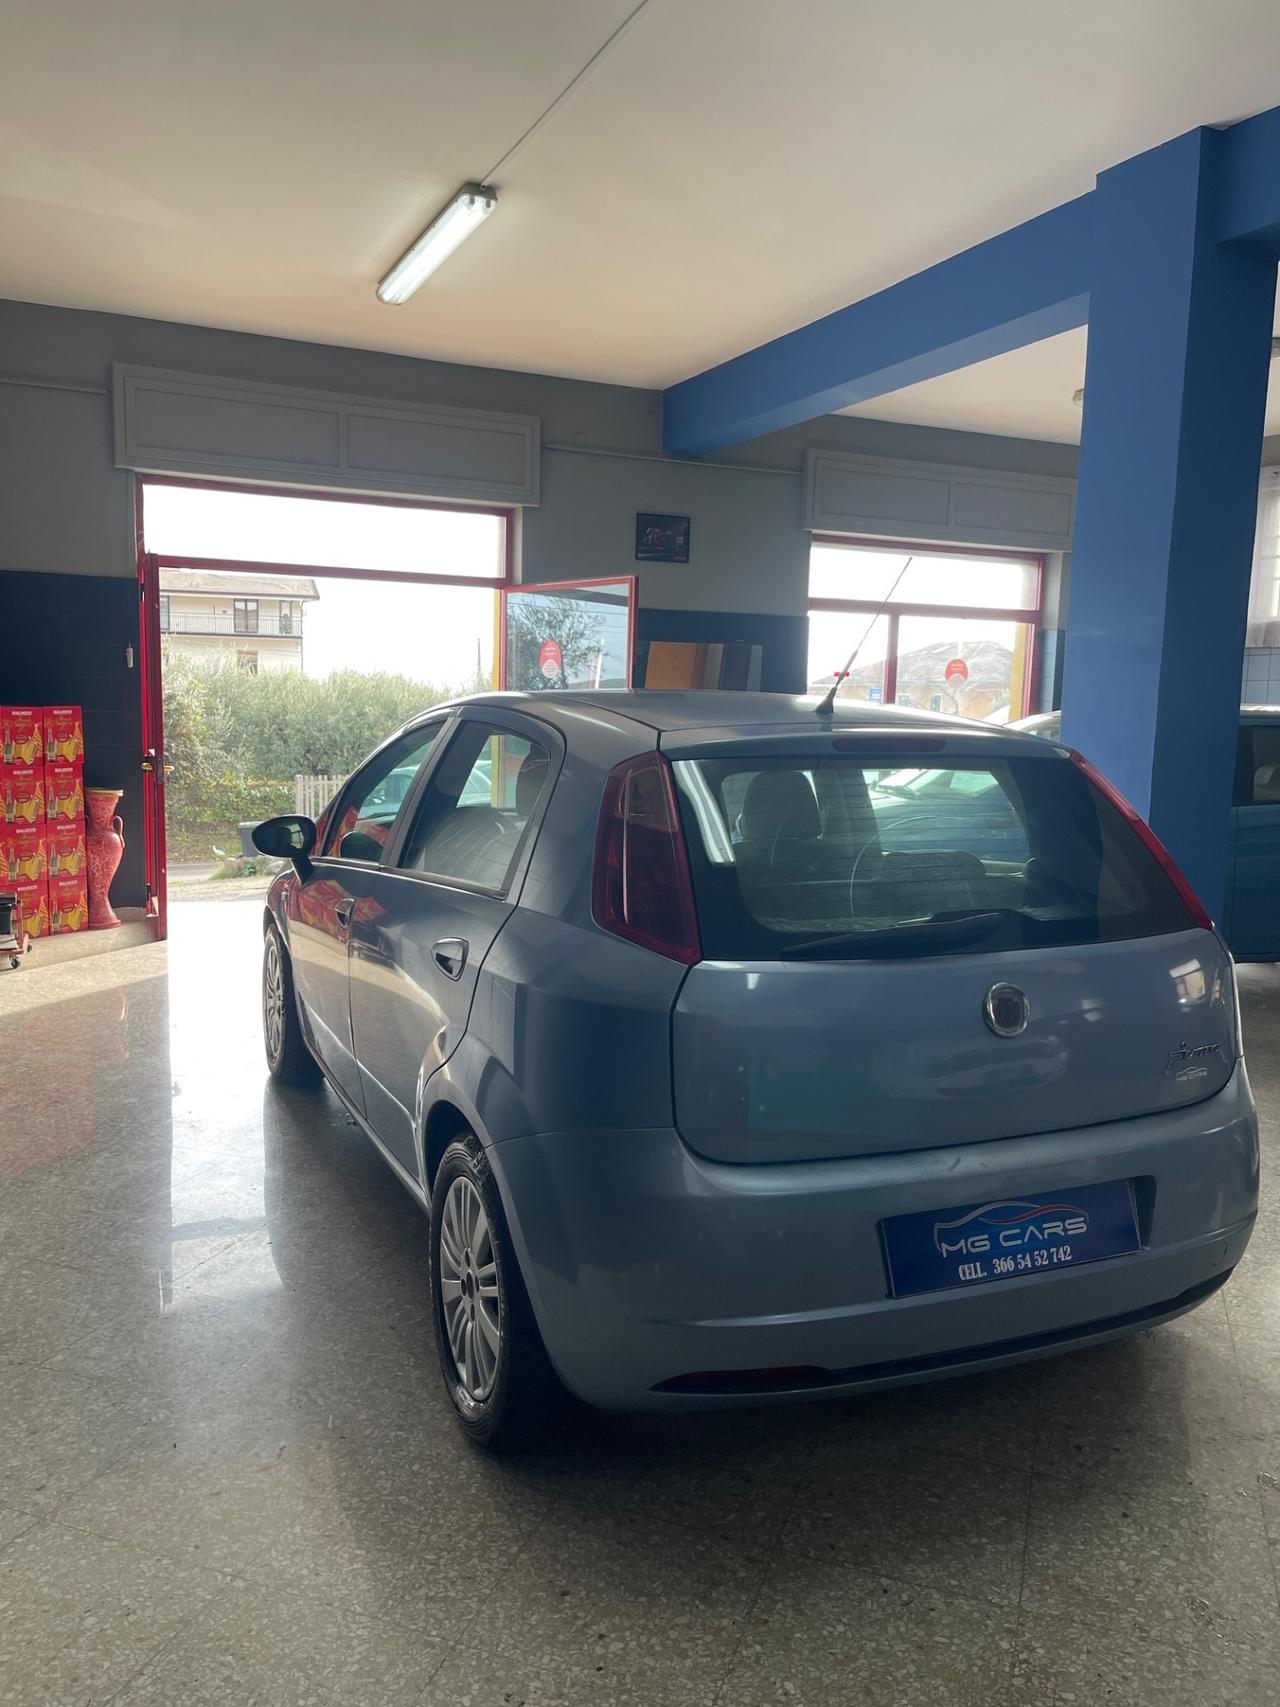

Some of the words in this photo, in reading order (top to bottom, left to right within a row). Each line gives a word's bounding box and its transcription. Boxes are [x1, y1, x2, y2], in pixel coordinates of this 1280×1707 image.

[940, 1234, 991, 1258] MG
[999, 1217, 1088, 1247] CARS
[958, 1262, 988, 1281] CELL.
[992, 1256, 1015, 1275] 366
[1017, 1252, 1032, 1270] 54
[1034, 1249, 1049, 1266] 52
[1051, 1245, 1073, 1263] 742
